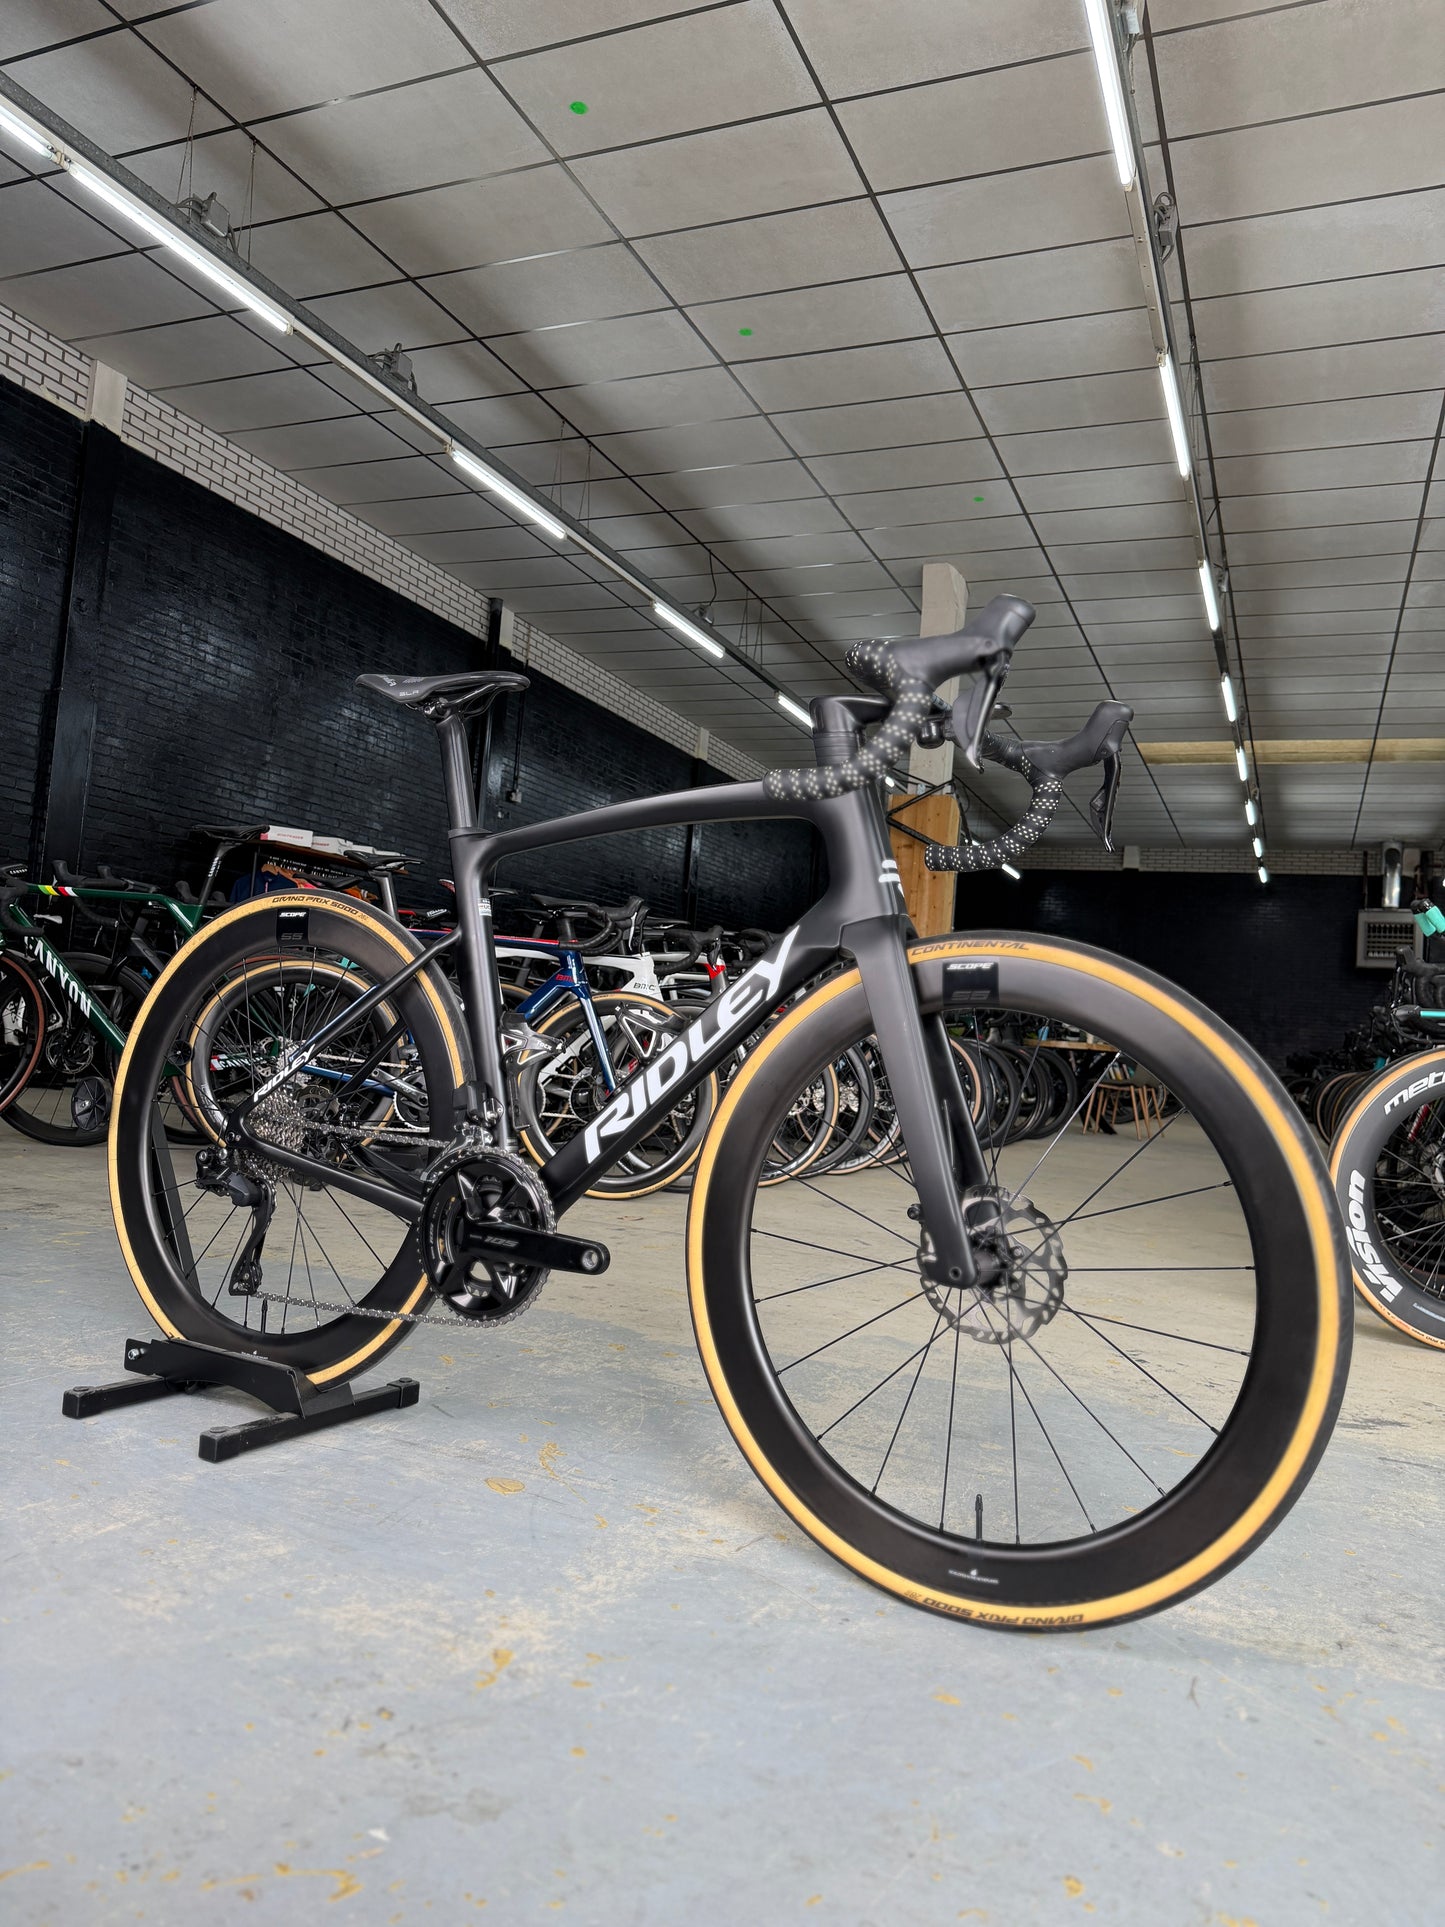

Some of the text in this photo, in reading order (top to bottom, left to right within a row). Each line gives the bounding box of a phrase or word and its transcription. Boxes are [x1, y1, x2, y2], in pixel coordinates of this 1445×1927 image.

[272, 895, 359, 915] GRAND PRIX 5000
[911, 940, 1030, 956] CONTINENTAL
[946, 962, 995, 971] SCOPE
[584, 925, 800, 1164] RIDLEY
[253, 1043, 316, 1103] RIDLEY
[484, 1235, 519, 1248] 105
[923, 1597, 1085, 1625] GRAND PRIX 5000
